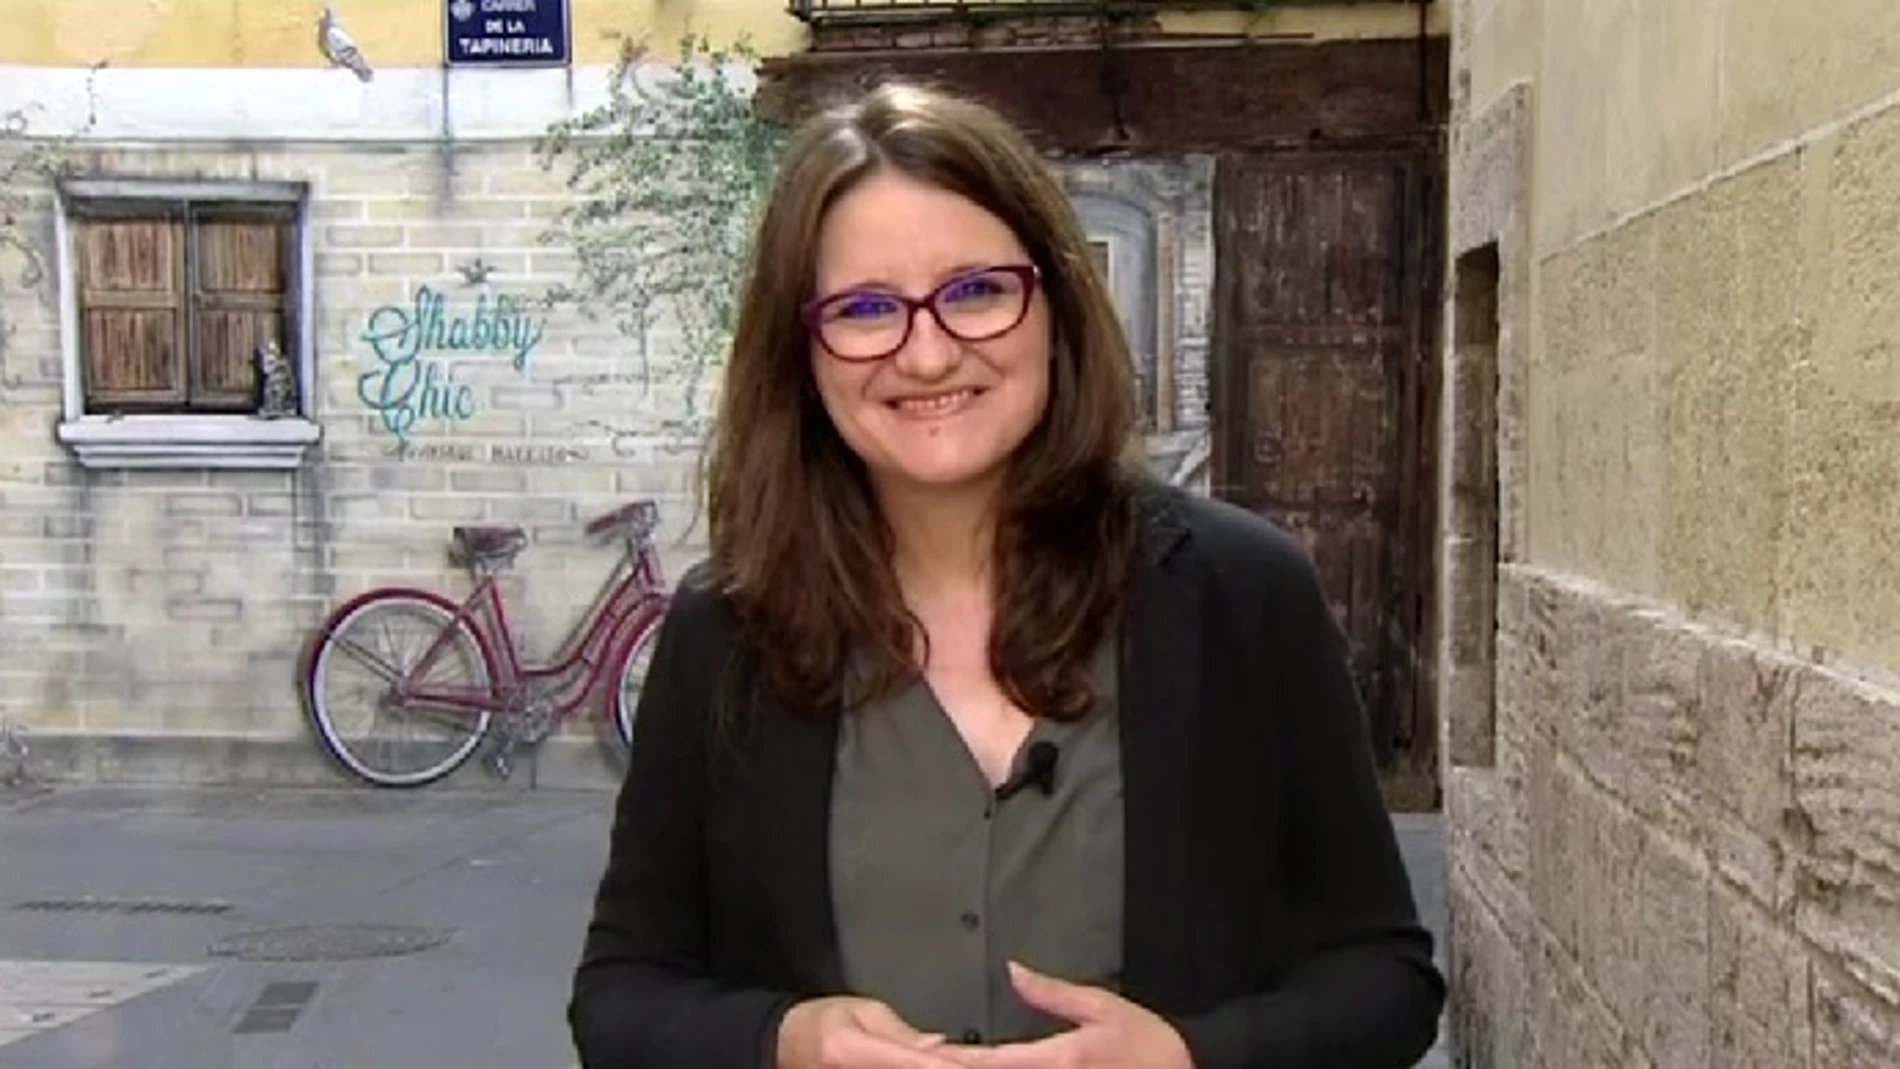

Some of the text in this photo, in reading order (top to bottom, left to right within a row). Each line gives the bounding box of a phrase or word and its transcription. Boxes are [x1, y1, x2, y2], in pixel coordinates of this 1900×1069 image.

[458, 37, 553, 54] TAPINERIA
[485, 19, 526, 34] DE LA
[360, 284, 548, 372] Shabby
[357, 359, 474, 438] Chic
